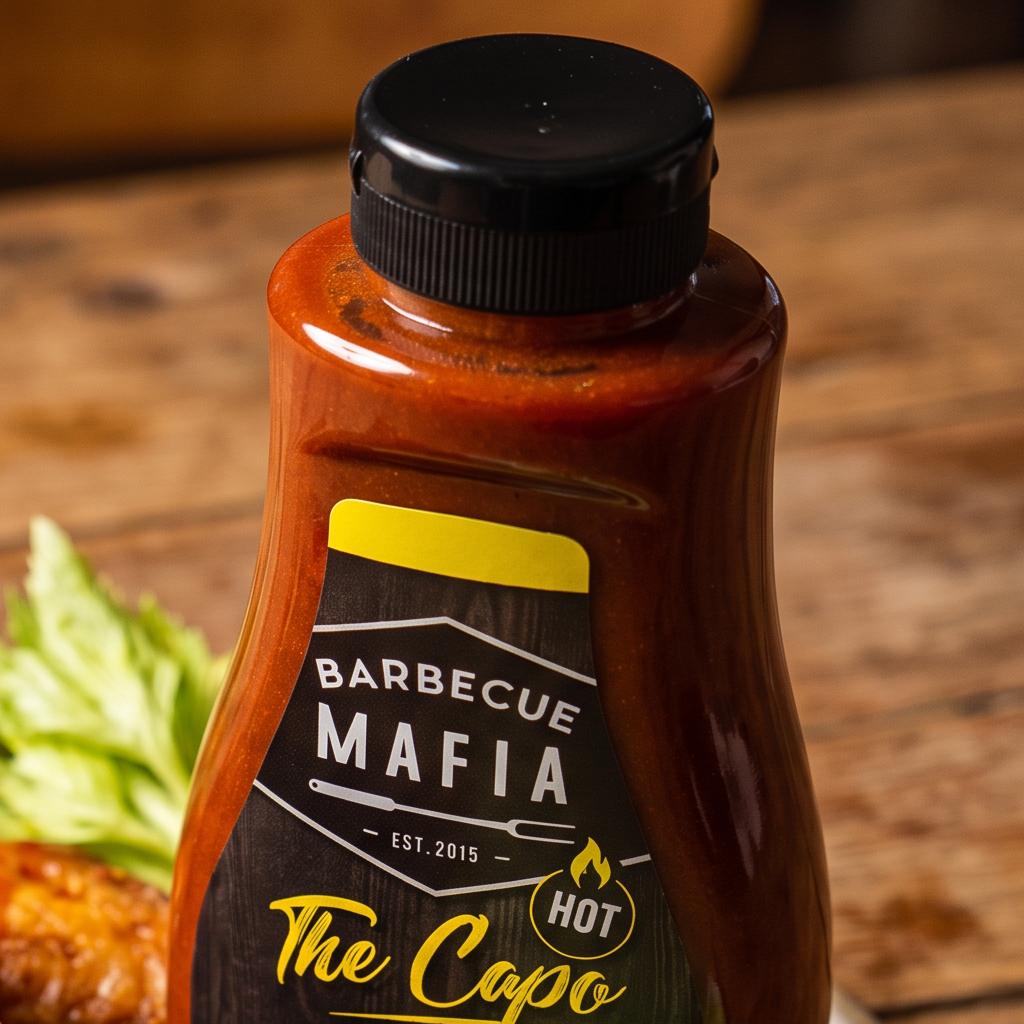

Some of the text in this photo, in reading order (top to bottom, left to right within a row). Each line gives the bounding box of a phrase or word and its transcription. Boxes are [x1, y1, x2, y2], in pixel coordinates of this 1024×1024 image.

[315, 657, 581, 735] BARBECUE
[317, 702, 568, 805] MAFIA
[269, 895, 391, 985] The
[547, 890, 622, 938] HOT
